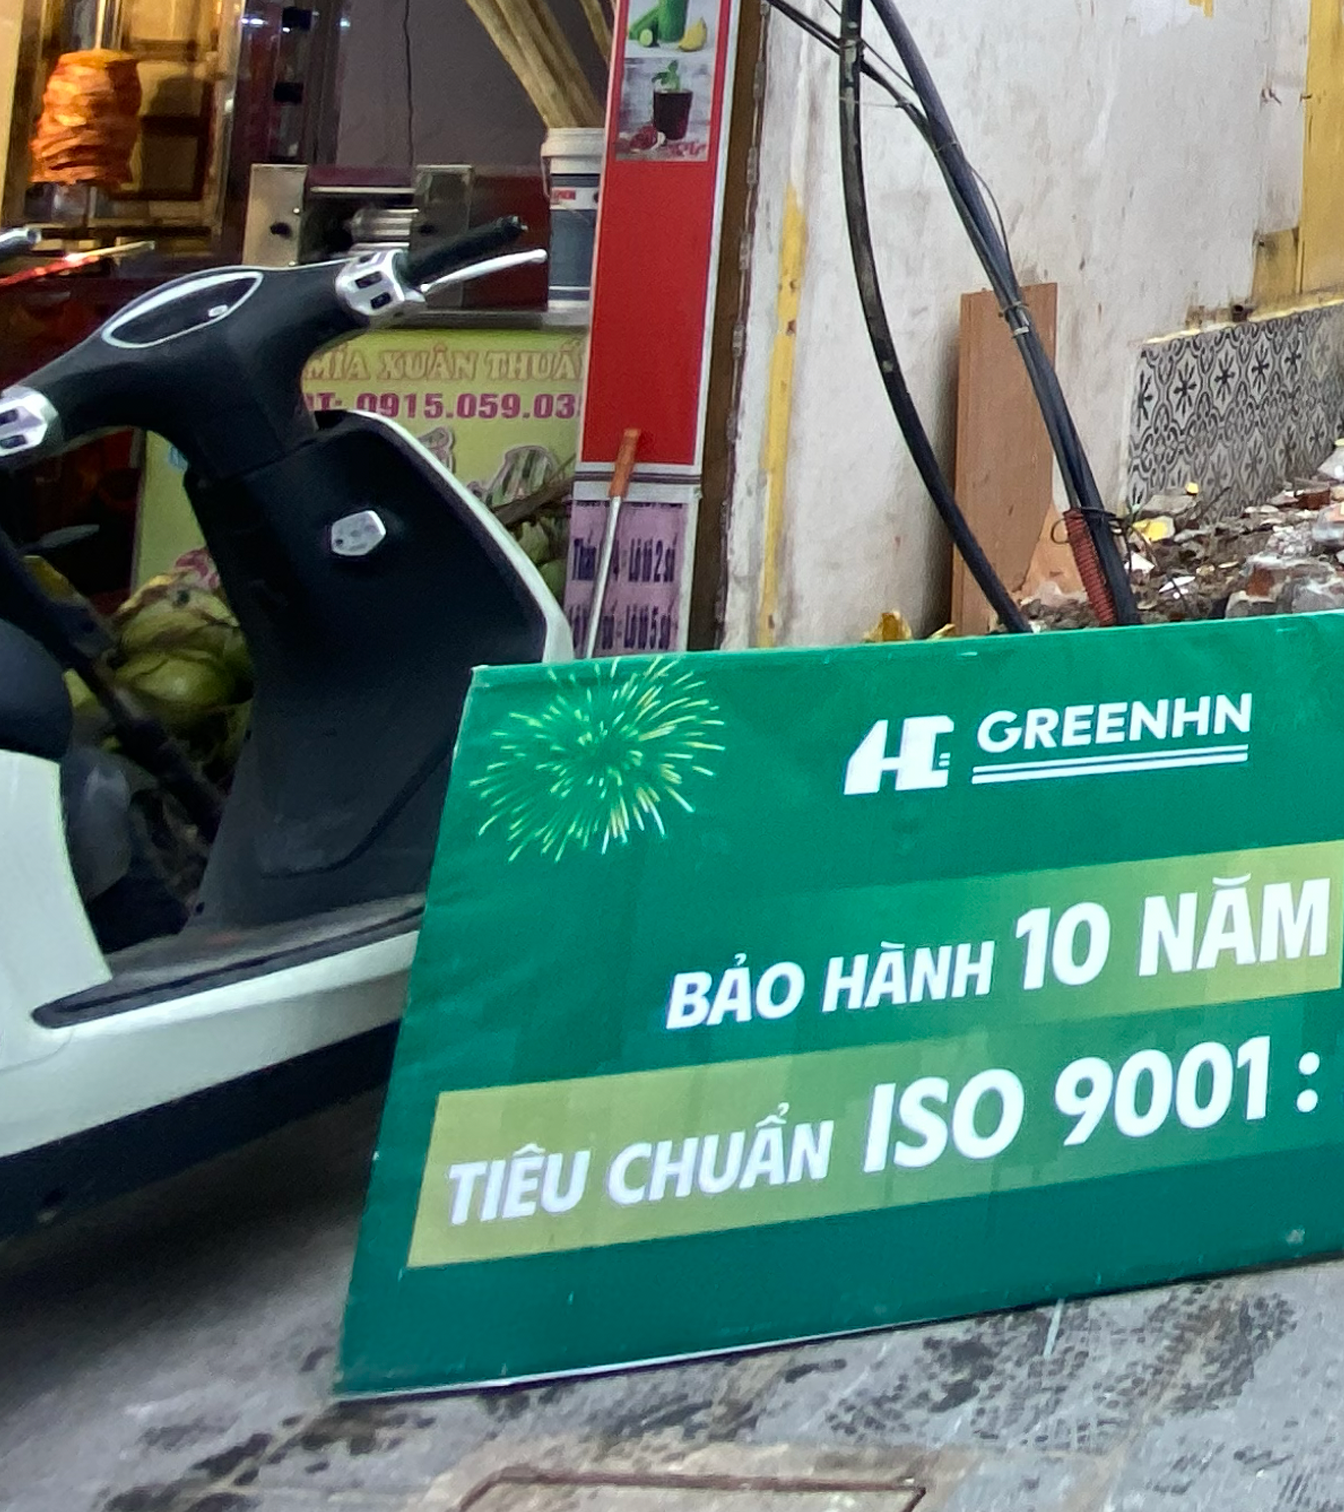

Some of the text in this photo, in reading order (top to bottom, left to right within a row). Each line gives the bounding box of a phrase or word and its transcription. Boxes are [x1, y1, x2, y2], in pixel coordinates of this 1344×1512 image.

[376, 341, 478, 381] XUÂN
[356, 392, 580, 419] 0915.059.03
[976, 692, 1253, 754] GREENHN
[665, 873, 1332, 1030] BẢO HÀNH 10 NĂM
[448, 1143, 590, 1227] TIÊU
[607, 1102, 834, 1207] CHUẨN
[863, 1067, 1025, 1173] ISO
[1054, 1035, 1271, 1147] 9001
